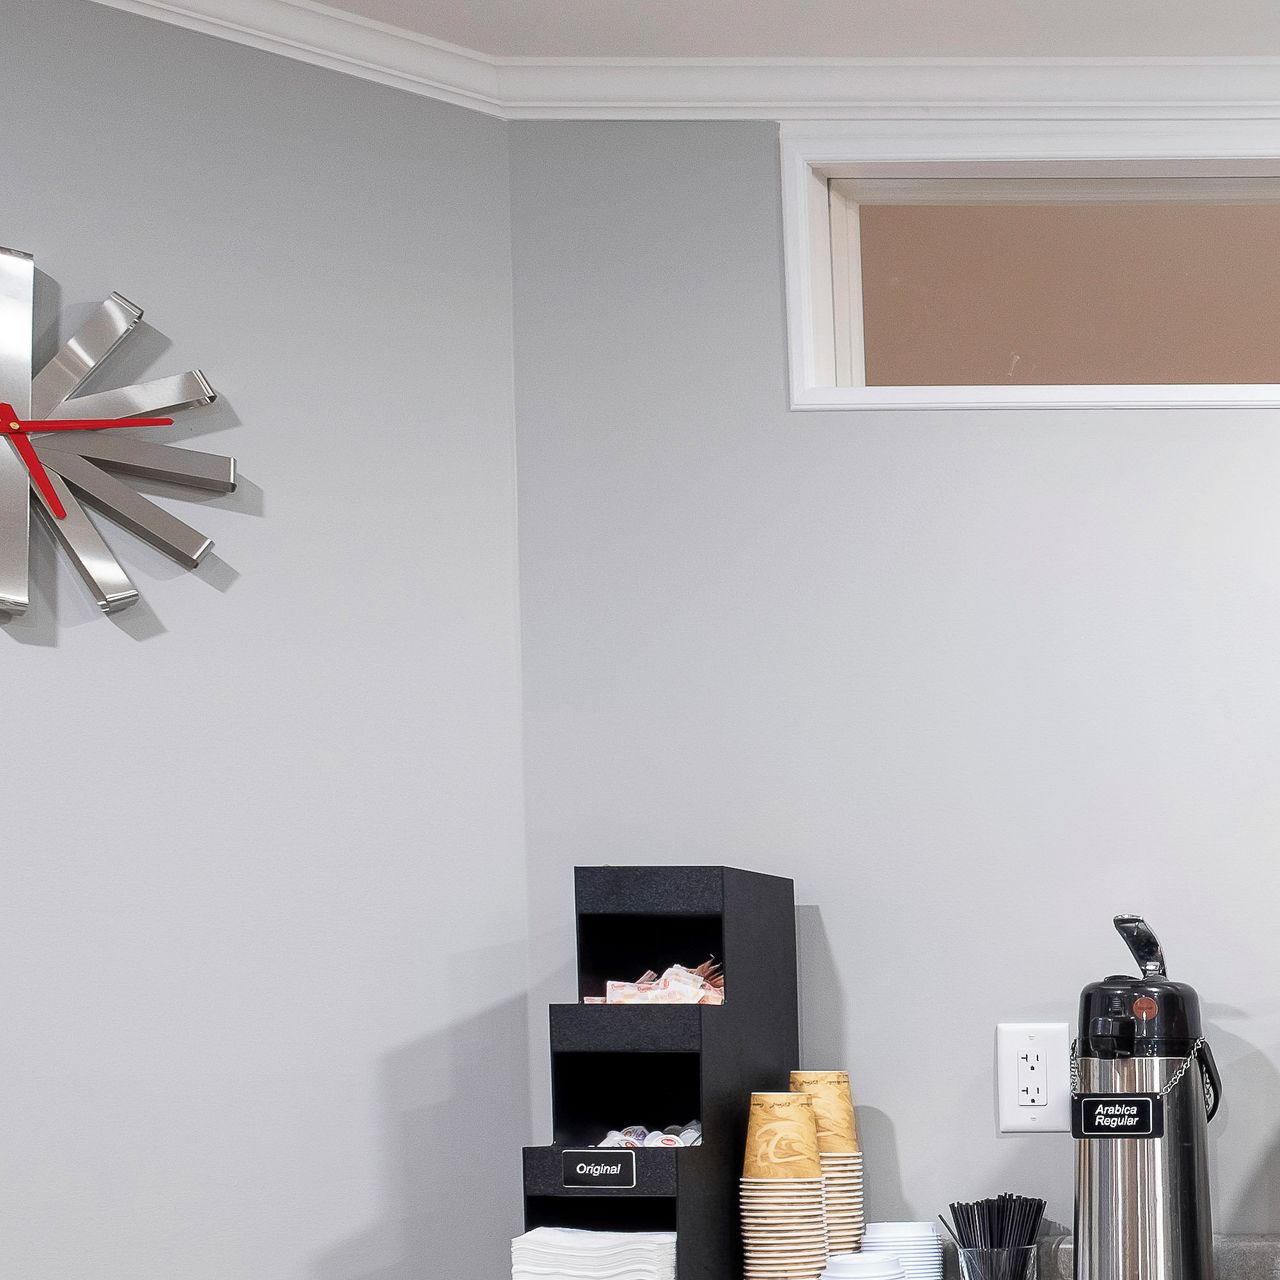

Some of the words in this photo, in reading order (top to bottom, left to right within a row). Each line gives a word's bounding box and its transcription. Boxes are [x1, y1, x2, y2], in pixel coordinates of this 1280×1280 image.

[1095, 1104, 1138, 1115] Arabica
[1095, 1115, 1139, 1128] Regular
[576, 1163, 622, 1177] Original
